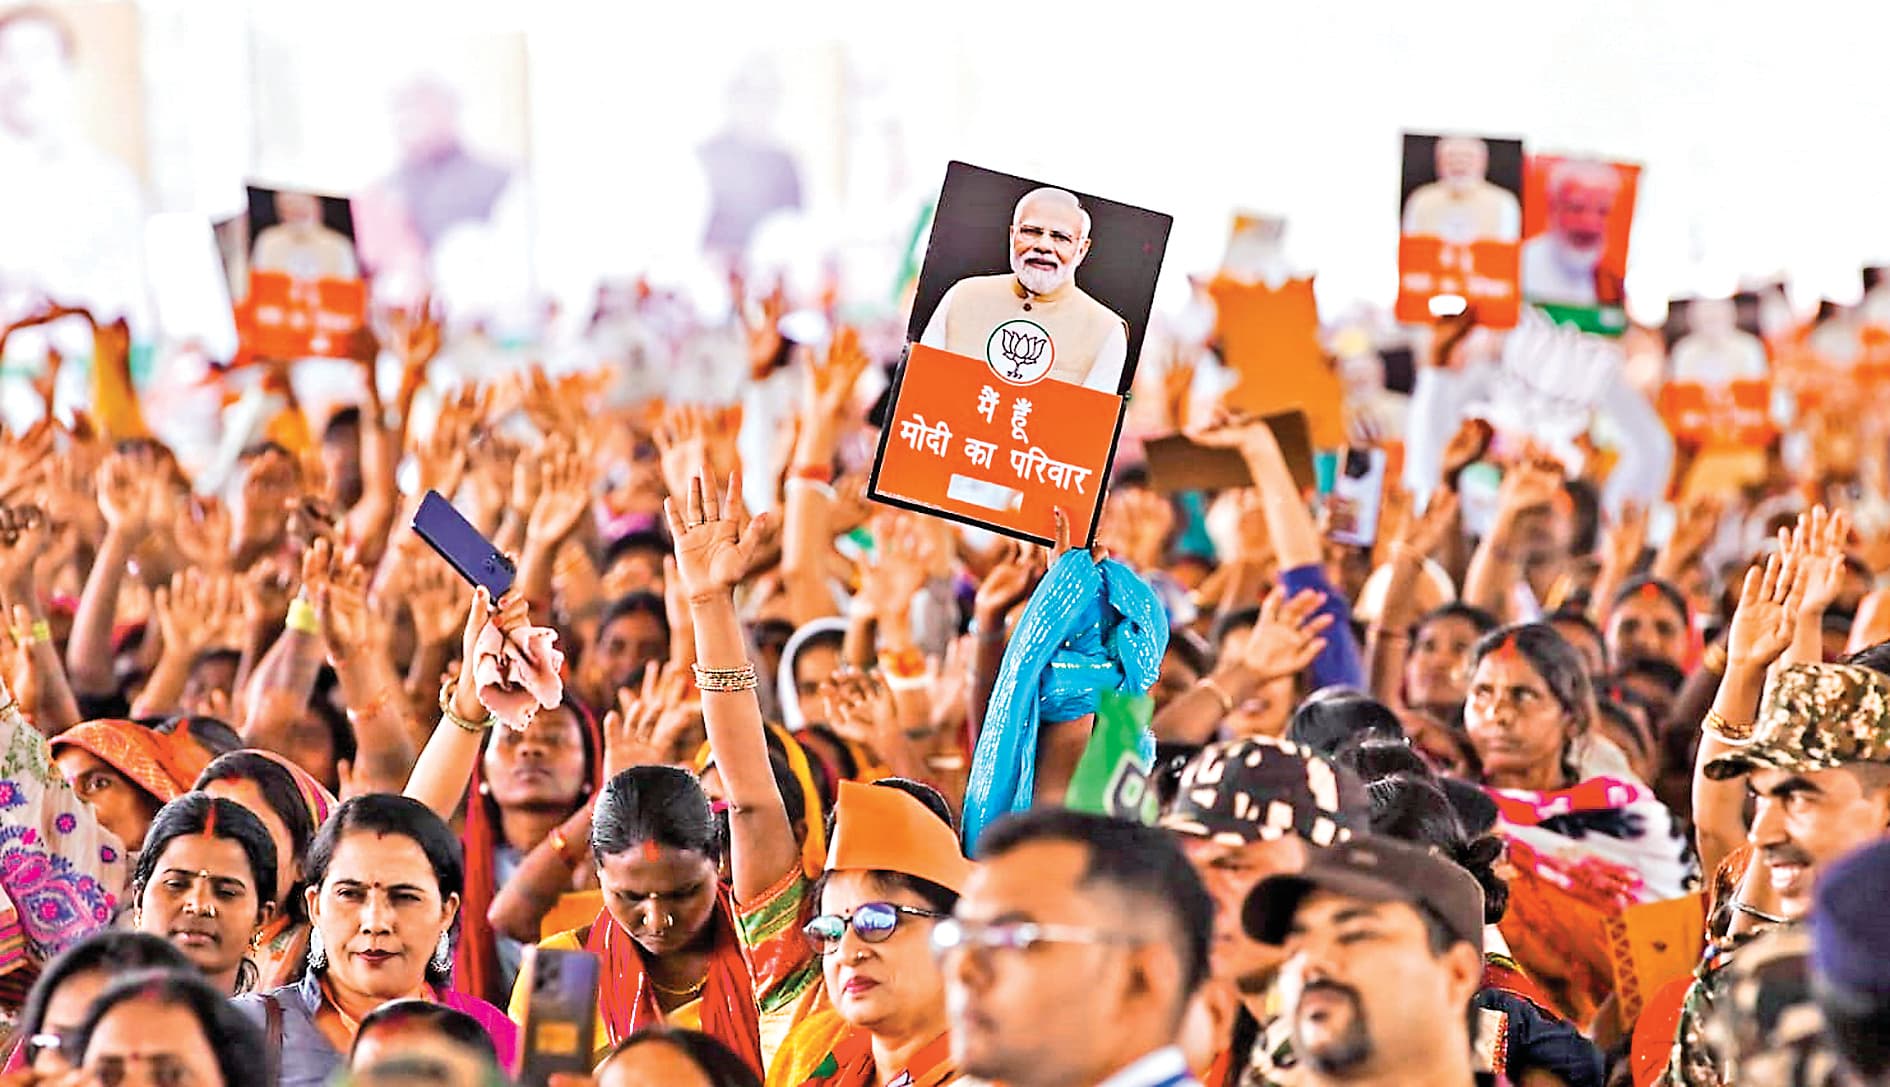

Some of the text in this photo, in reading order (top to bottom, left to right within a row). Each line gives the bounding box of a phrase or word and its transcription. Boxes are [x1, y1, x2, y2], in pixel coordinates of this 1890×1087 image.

[977, 385, 1032, 443] मैं हूँ
[900, 414, 1092, 494] मोदी का परिवार
